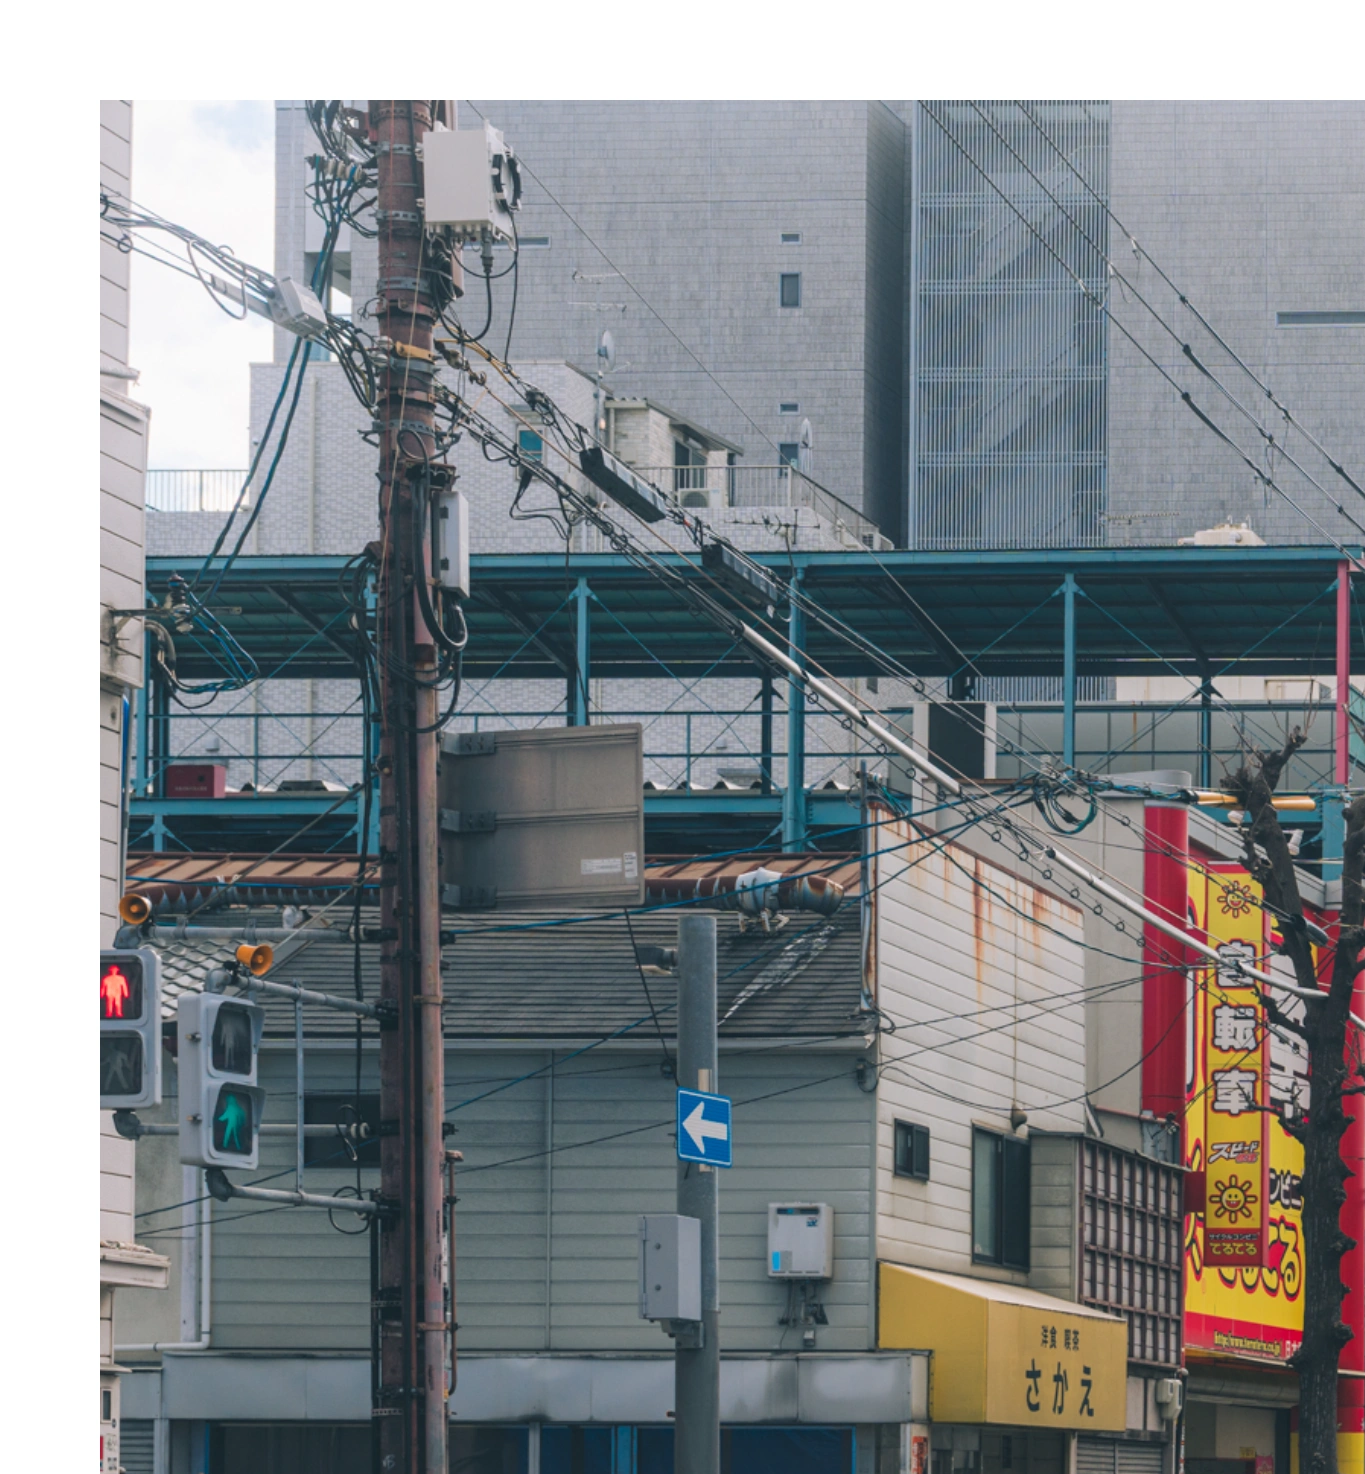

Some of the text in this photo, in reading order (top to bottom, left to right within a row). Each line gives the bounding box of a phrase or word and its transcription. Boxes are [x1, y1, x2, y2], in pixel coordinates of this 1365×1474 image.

[1211, 939, 1258, 1116] 自転車
[1209, 1242, 1258, 1256] てるてる
[1025, 1357, 1095, 1418] さかえ
